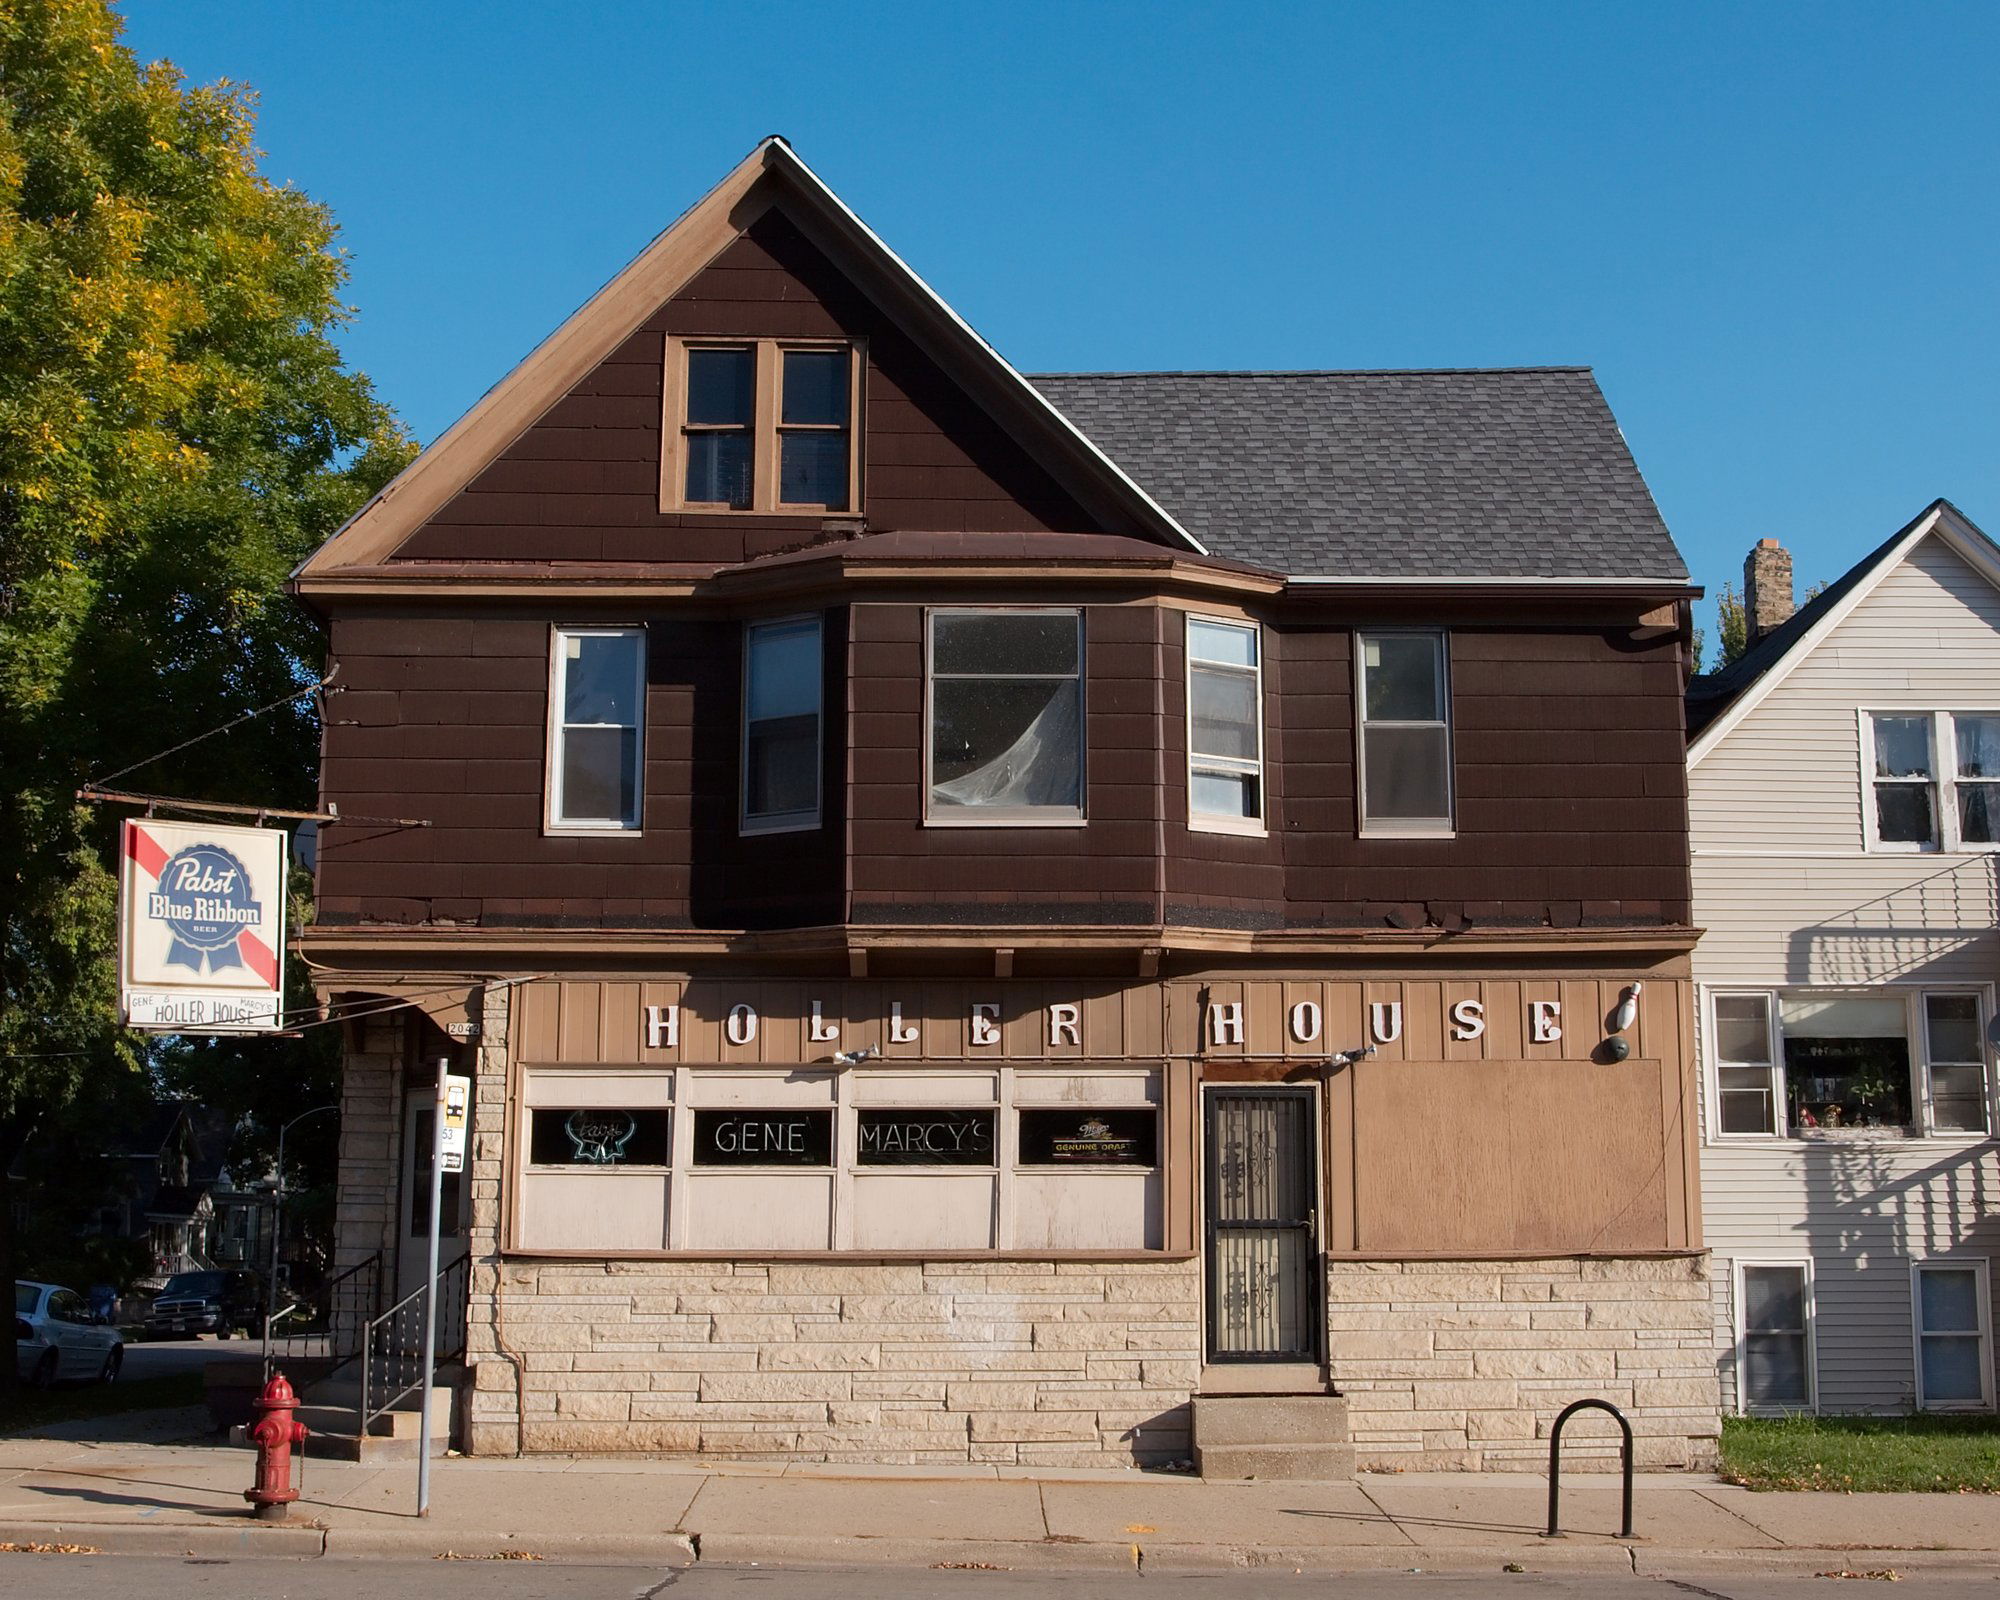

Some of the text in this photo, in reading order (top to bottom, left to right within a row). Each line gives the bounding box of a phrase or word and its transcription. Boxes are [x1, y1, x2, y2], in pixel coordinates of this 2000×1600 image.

[174, 857, 237, 895] Pabst
[150, 894, 260, 924] Blue Ribbon
[132, 995, 153, 1007] GENE
[240, 997, 273, 1013] MARCY'S
[155, 1000, 254, 1025] HOLLER HOUSE
[449, 1023, 480, 1034] 2042
[645, 999, 1563, 1047] HOLLER HOUSE
[442, 1128, 453, 1140] 53
[715, 1121, 807, 1152] GENE
[859, 1117, 993, 1153] MARCY'S
[1055, 1143, 1098, 1151] GENUINE
